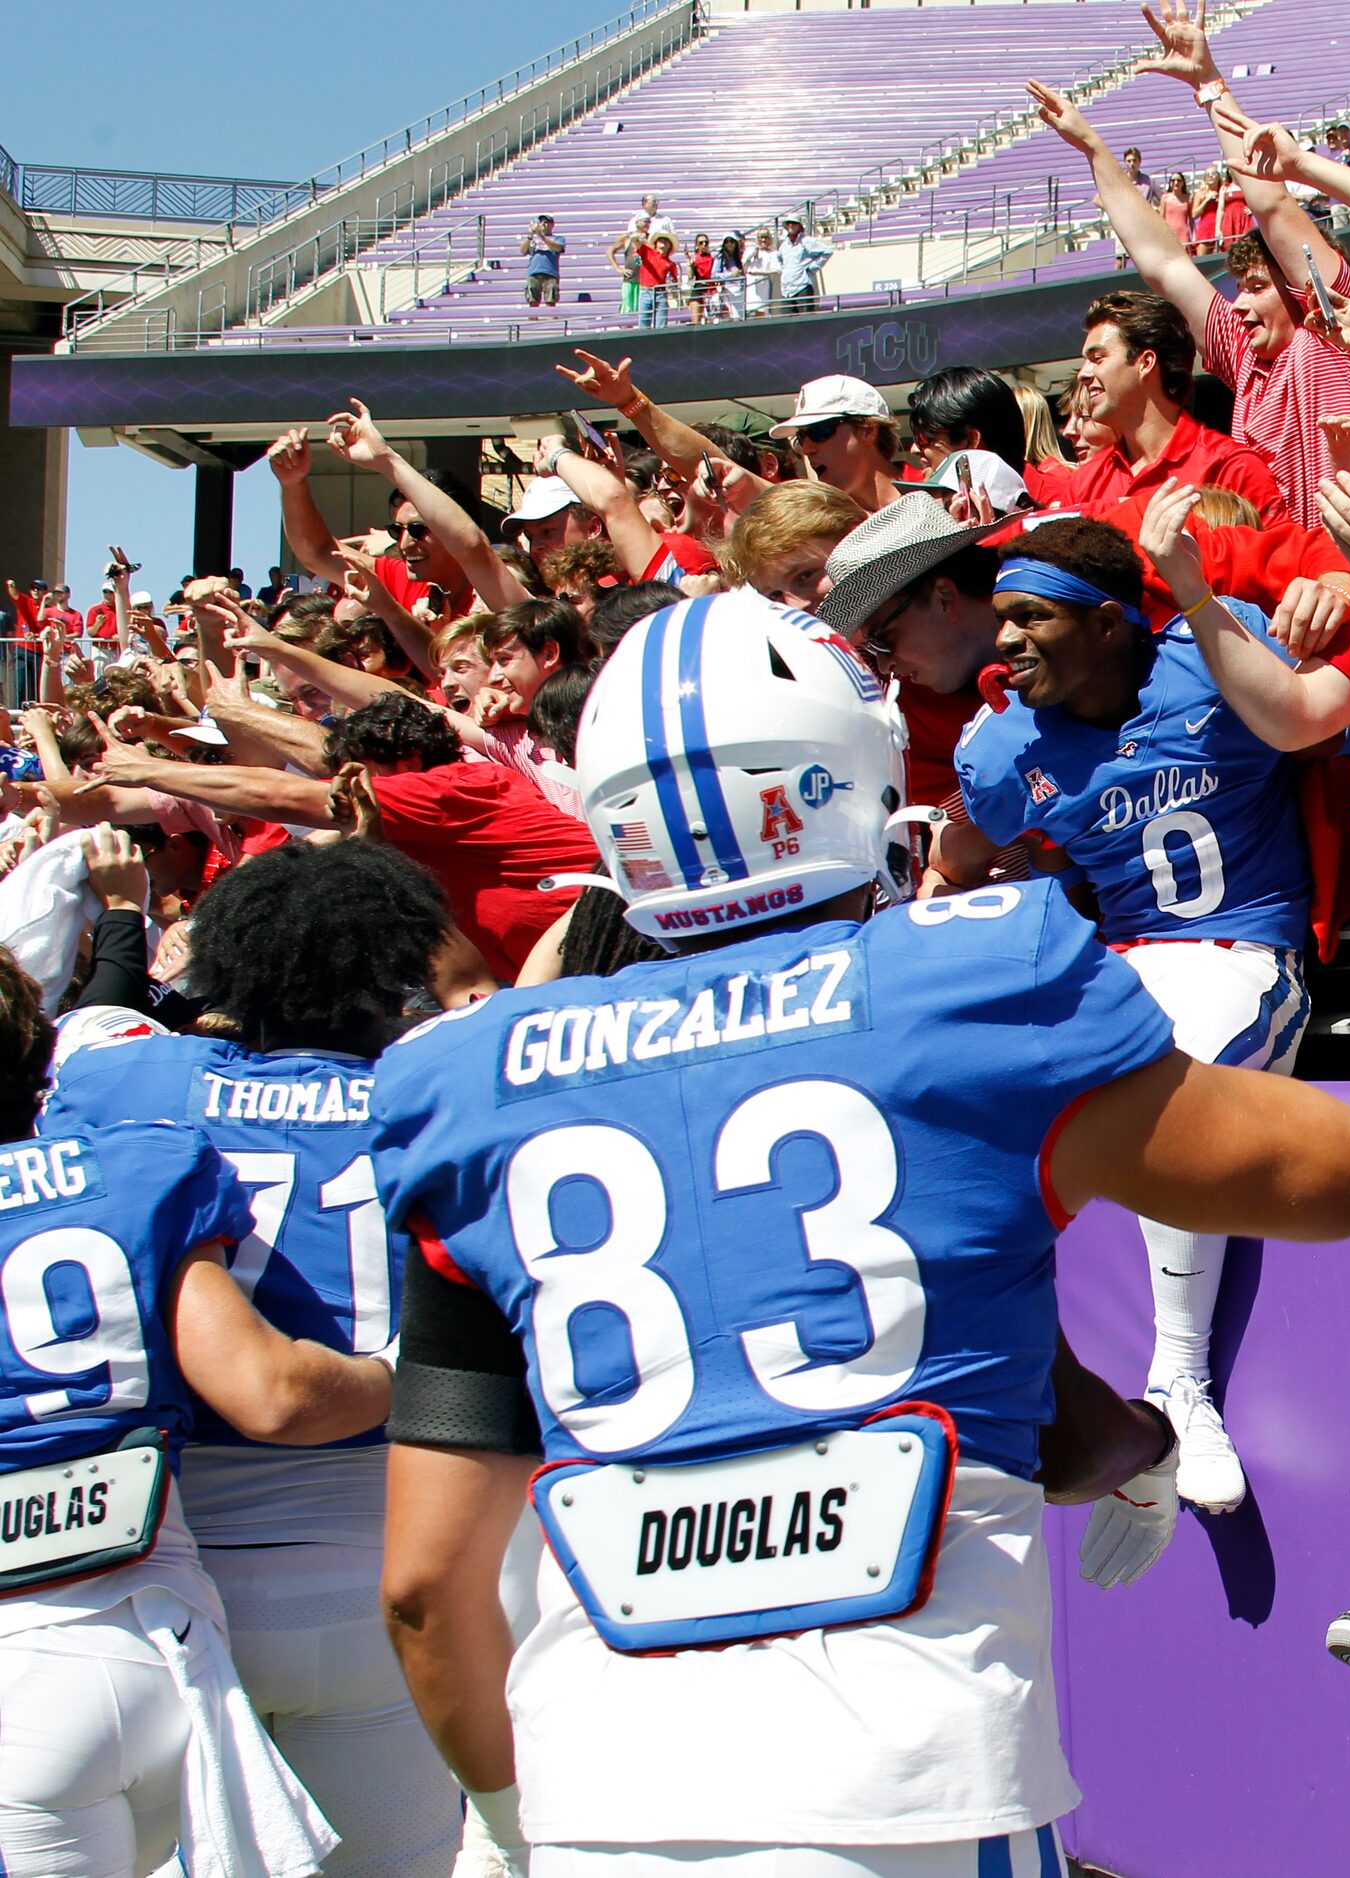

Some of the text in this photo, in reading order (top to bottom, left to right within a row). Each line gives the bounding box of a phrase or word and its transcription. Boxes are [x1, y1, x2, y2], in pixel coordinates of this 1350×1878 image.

[836, 320, 940, 377] TCU
[803, 773, 829, 800] JP
[1099, 767, 1219, 832] Dallas
[772, 838, 801, 860] P6
[1142, 811, 1225, 919] 0
[654, 883, 804, 931] MUSTANGS
[505, 950, 852, 1086] GONZALEZ
[203, 1077, 375, 1123] THOMAS
[219, 1153, 392, 1354] 71
[507, 1080, 926, 1453] 83
[637, 1487, 847, 1575] DOUGLAS
